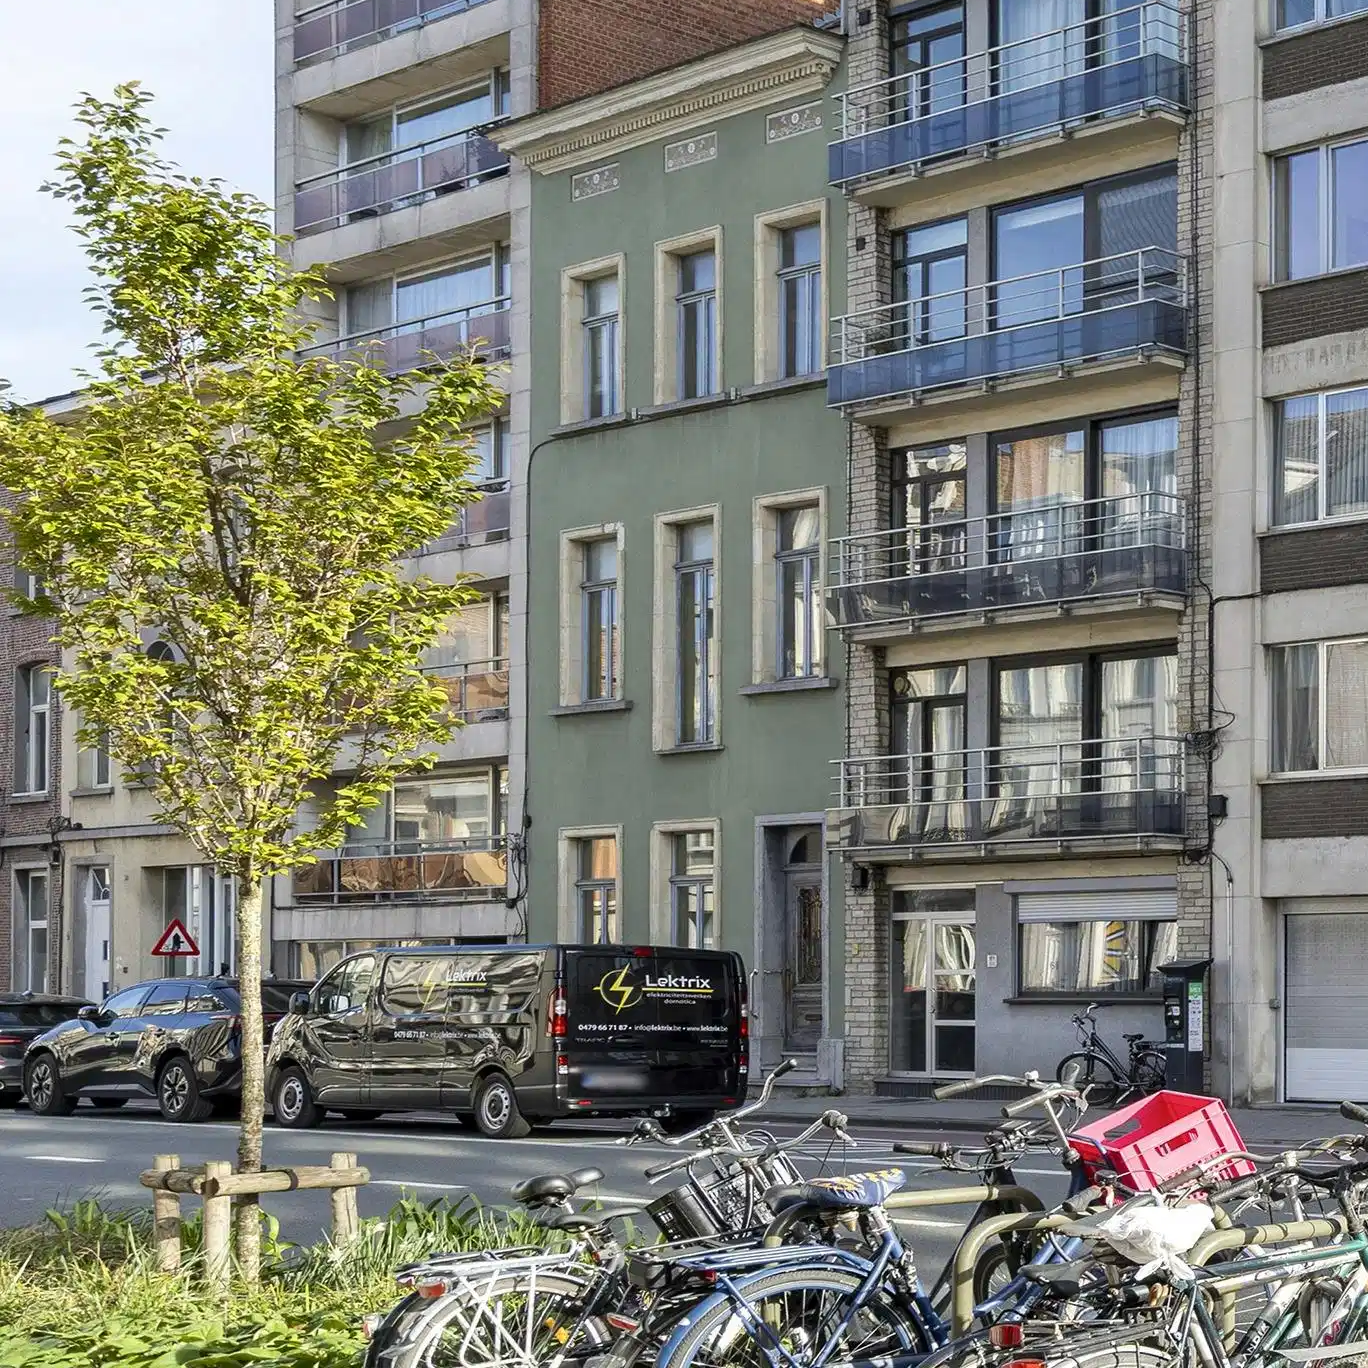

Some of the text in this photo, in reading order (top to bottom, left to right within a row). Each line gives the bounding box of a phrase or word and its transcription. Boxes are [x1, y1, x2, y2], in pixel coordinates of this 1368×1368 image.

[446, 969, 487, 982] Lektrix
[645, 974, 711, 988] Lektrix
[634, 1023, 682, 1032] info@lektrix.be
[686, 1023, 728, 1032] www.lektrix.be
